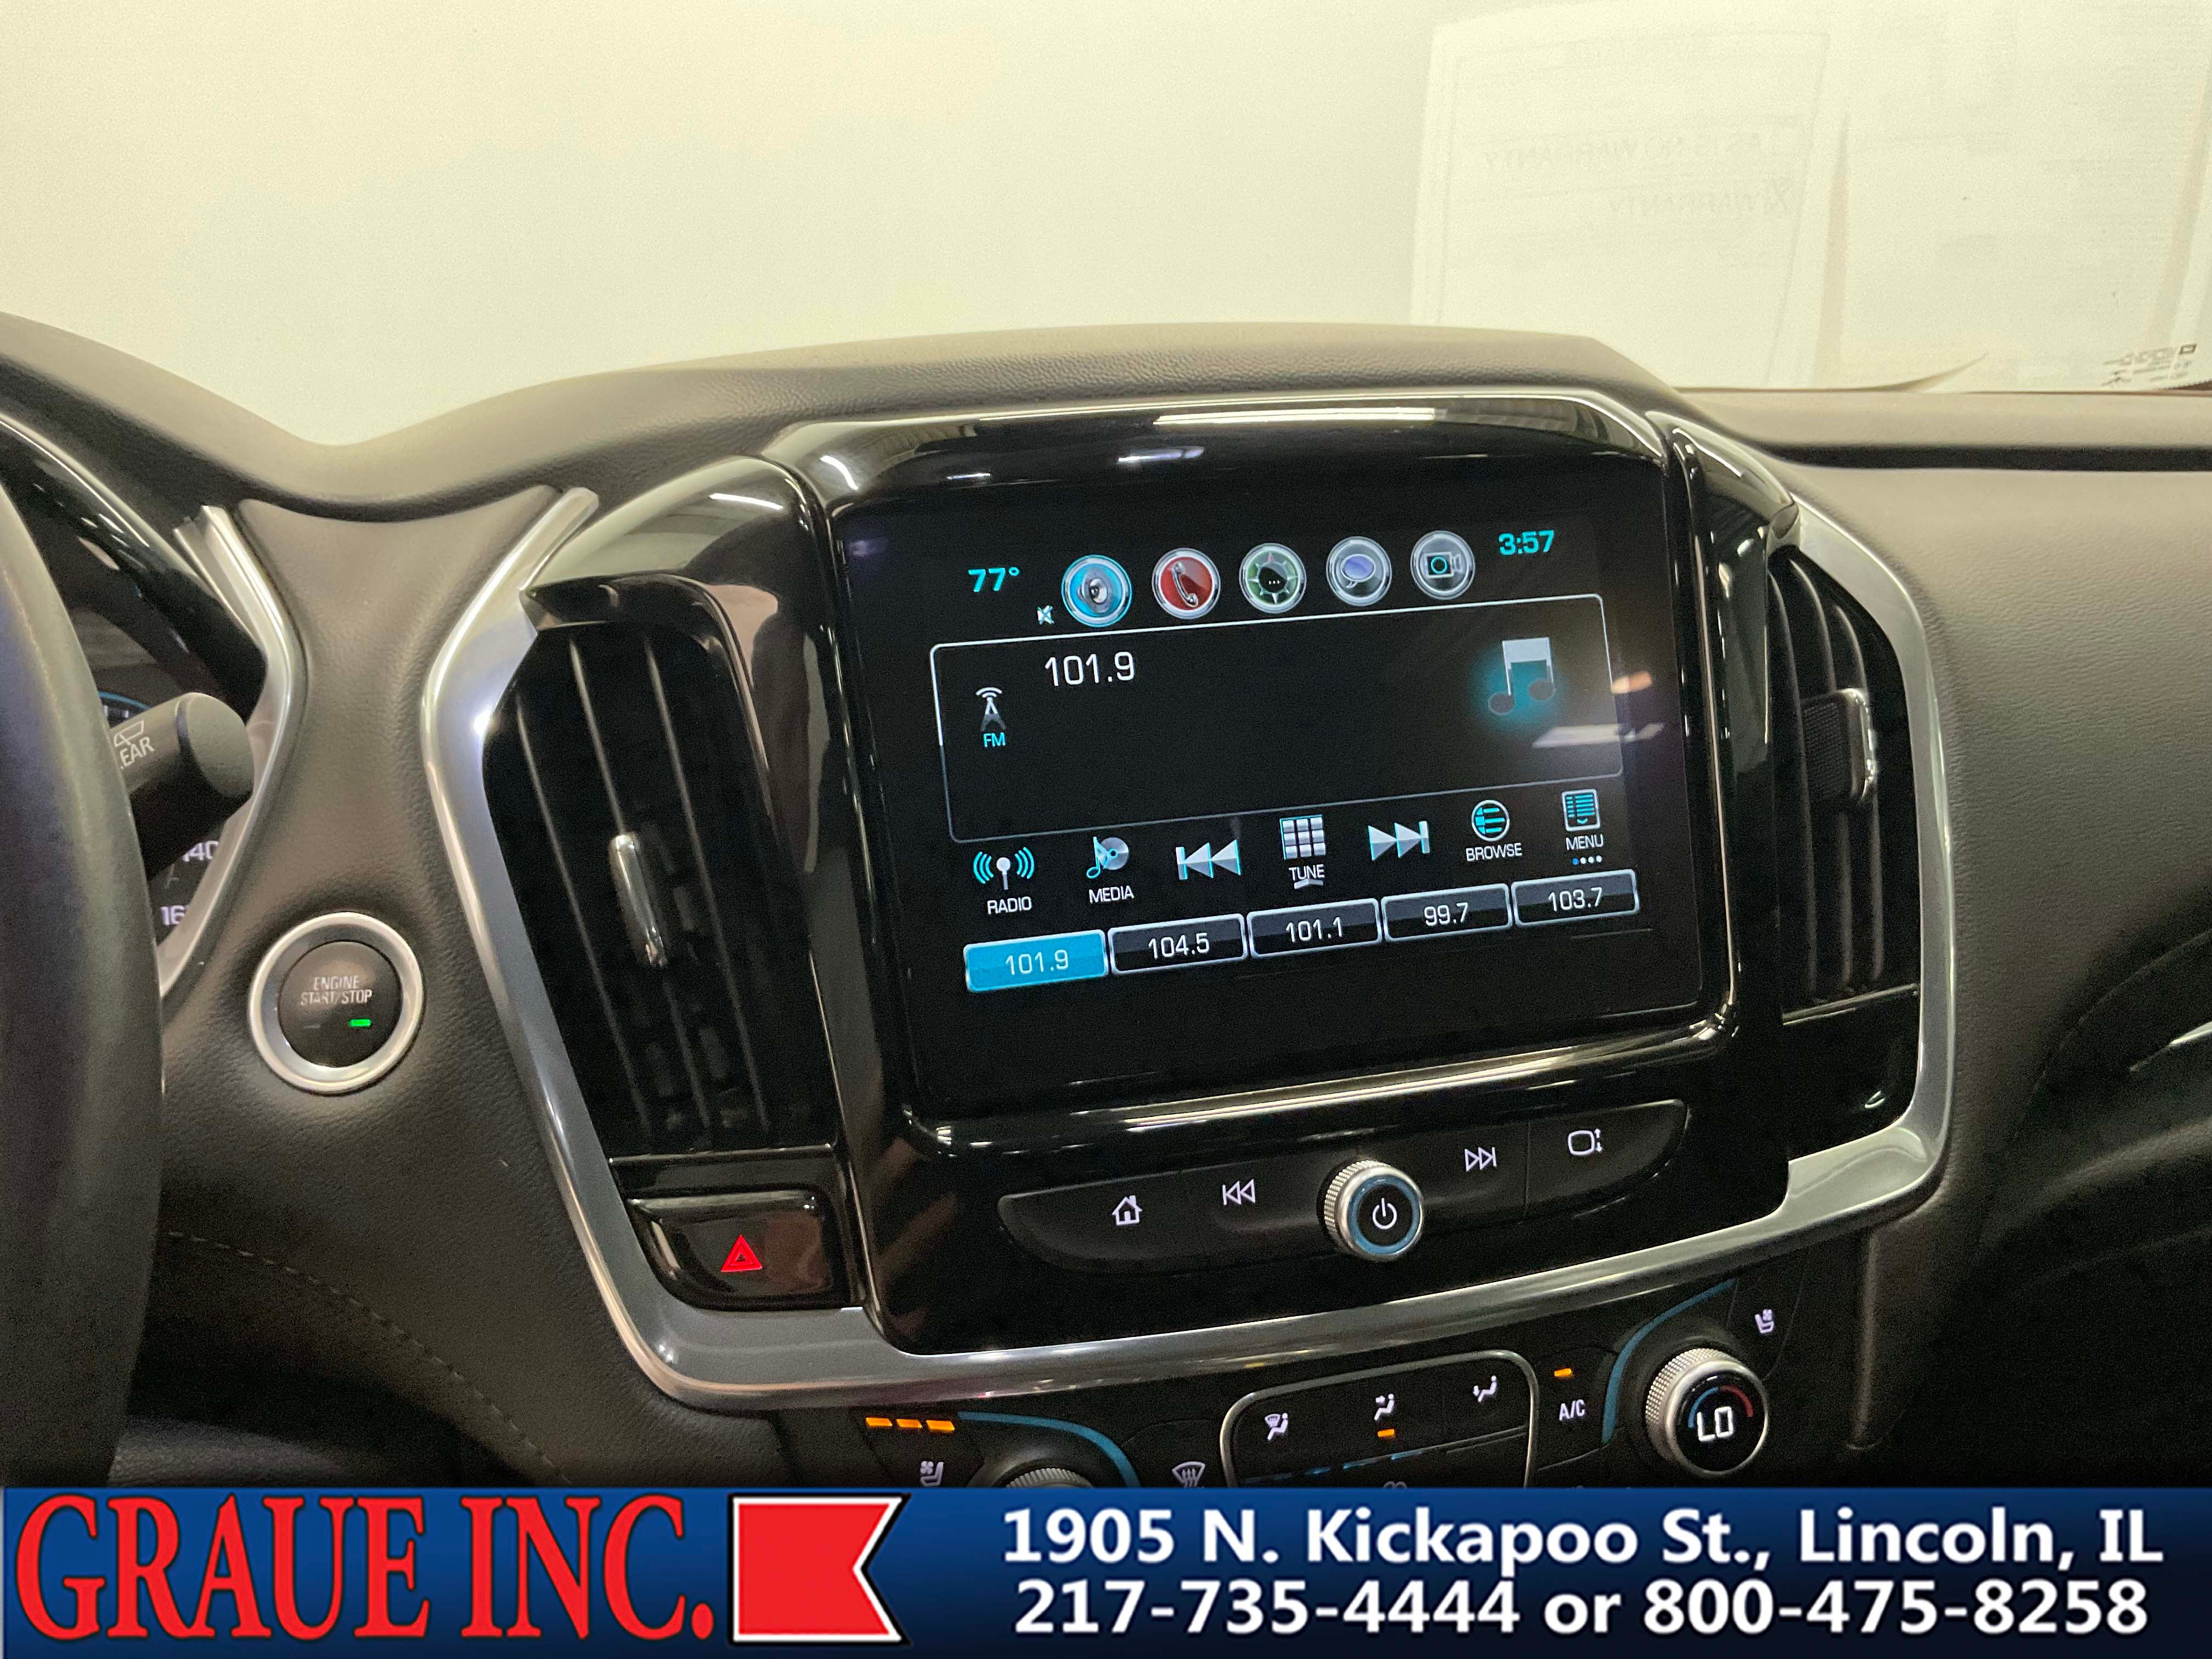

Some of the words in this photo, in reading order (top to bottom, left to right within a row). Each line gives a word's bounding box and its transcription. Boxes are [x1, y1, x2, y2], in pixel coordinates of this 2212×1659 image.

[1499, 531, 1554, 555] 3:57
[1046, 652, 1135, 686] 101.9
[984, 733, 1006, 748] FM
[120, 736, 155, 769] EAR
[182, 840, 219, 862] 40
[1466, 843, 1522, 862] BROWSE
[1566, 834, 1604, 850] MENU
[1289, 864, 1325, 881] TUNE
[1090, 886, 1135, 904] MEDIA
[1549, 888, 1602, 912] 103.7
[988, 897, 1032, 915] RADIO
[1425, 903, 1469, 926] 99.7
[1286, 918, 1342, 943] 101.1
[1148, 933, 1210, 960] 104.5
[1008, 951, 1068, 975] 101.9
[313, 975, 360, 990] ENGINE
[301, 989, 373, 1005] START/STOP
[1560, 1400, 1585, 1421] A/C
